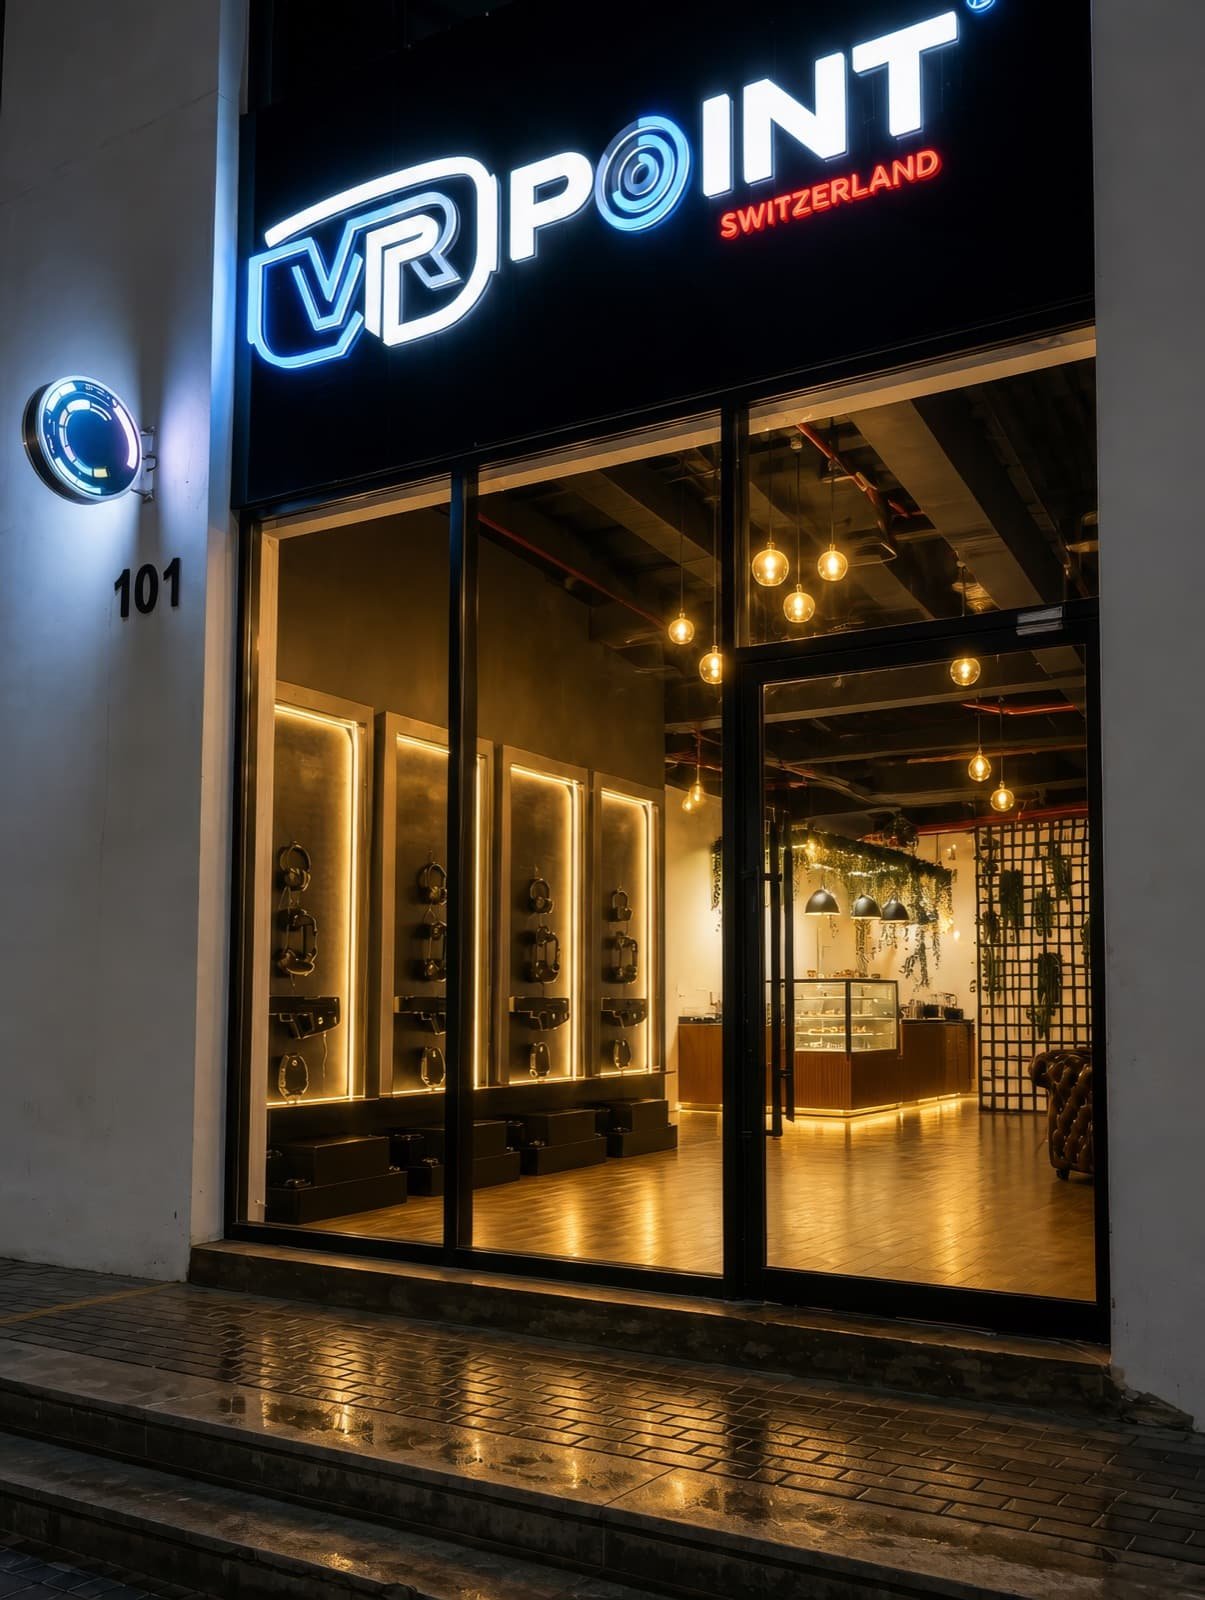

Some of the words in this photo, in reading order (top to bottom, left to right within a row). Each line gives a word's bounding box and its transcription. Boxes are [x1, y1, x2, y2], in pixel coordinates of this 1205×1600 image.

[249, 157, 498, 367] VR
[508, 11, 959, 262] POINT
[719, 149, 942, 239] SWITZERLAND
[114, 557, 181, 619] 101
